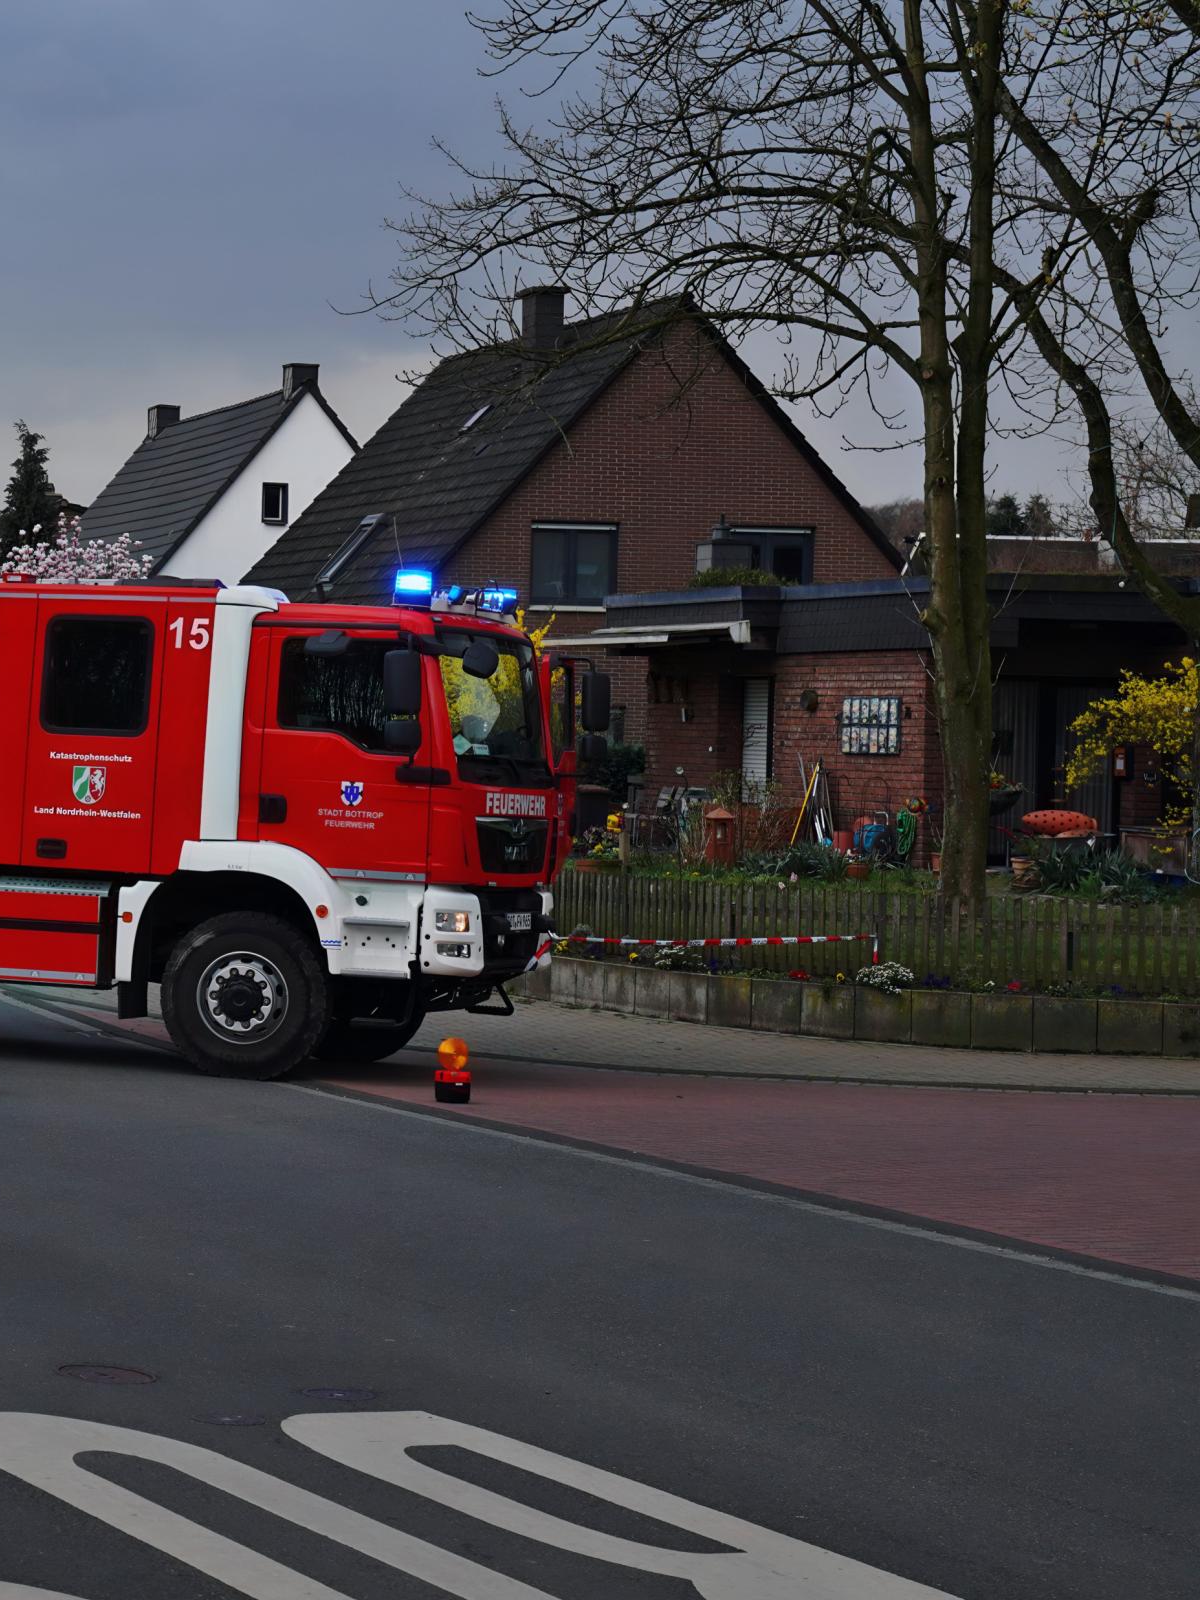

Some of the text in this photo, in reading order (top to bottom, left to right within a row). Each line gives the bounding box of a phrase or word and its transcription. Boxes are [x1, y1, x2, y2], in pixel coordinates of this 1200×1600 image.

[169, 616, 210, 650] 15
[49, 751, 133, 762] Katastrophenschutz
[486, 792, 546, 817] FEUERWEHR
[34, 806, 142, 819] Land Nordrhein-Westfalen
[318, 808, 384, 819] STADT BOTTROP
[324, 819, 375, 830] FEUERWEHR
